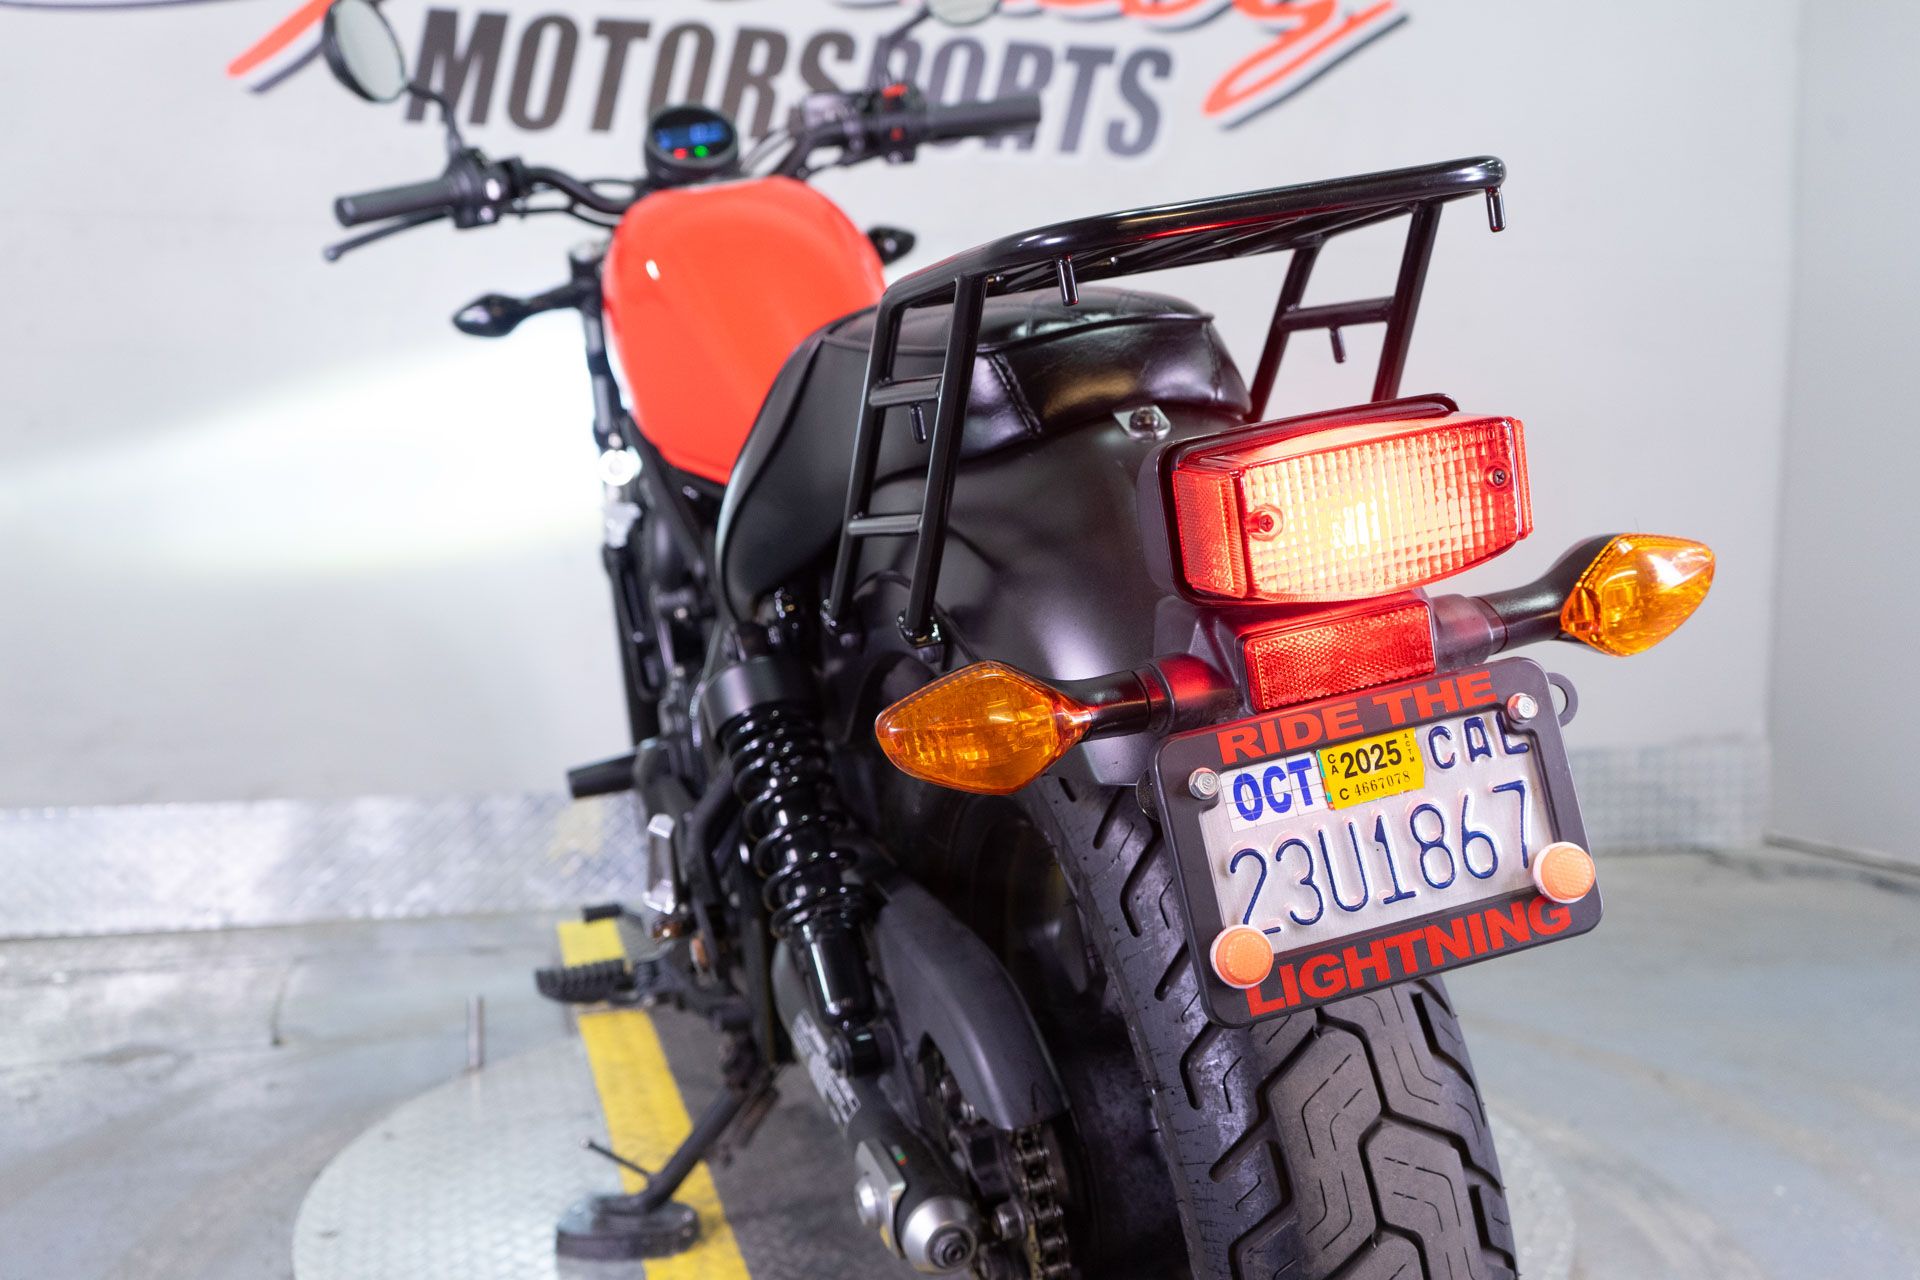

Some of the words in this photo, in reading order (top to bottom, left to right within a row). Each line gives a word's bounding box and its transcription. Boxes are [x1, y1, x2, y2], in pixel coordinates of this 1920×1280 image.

[1217, 703, 1364, 765] RIDE
[1373, 671, 1498, 726] THE
[1428, 711, 1530, 769] CAL
[1233, 757, 1313, 821] OCT
[1340, 739, 1402, 779] 2025
[1354, 771, 1411, 796] 4667078
[1229, 779, 1530, 934] 23U1867
[1246, 895, 1572, 1017] LIGHTNING
